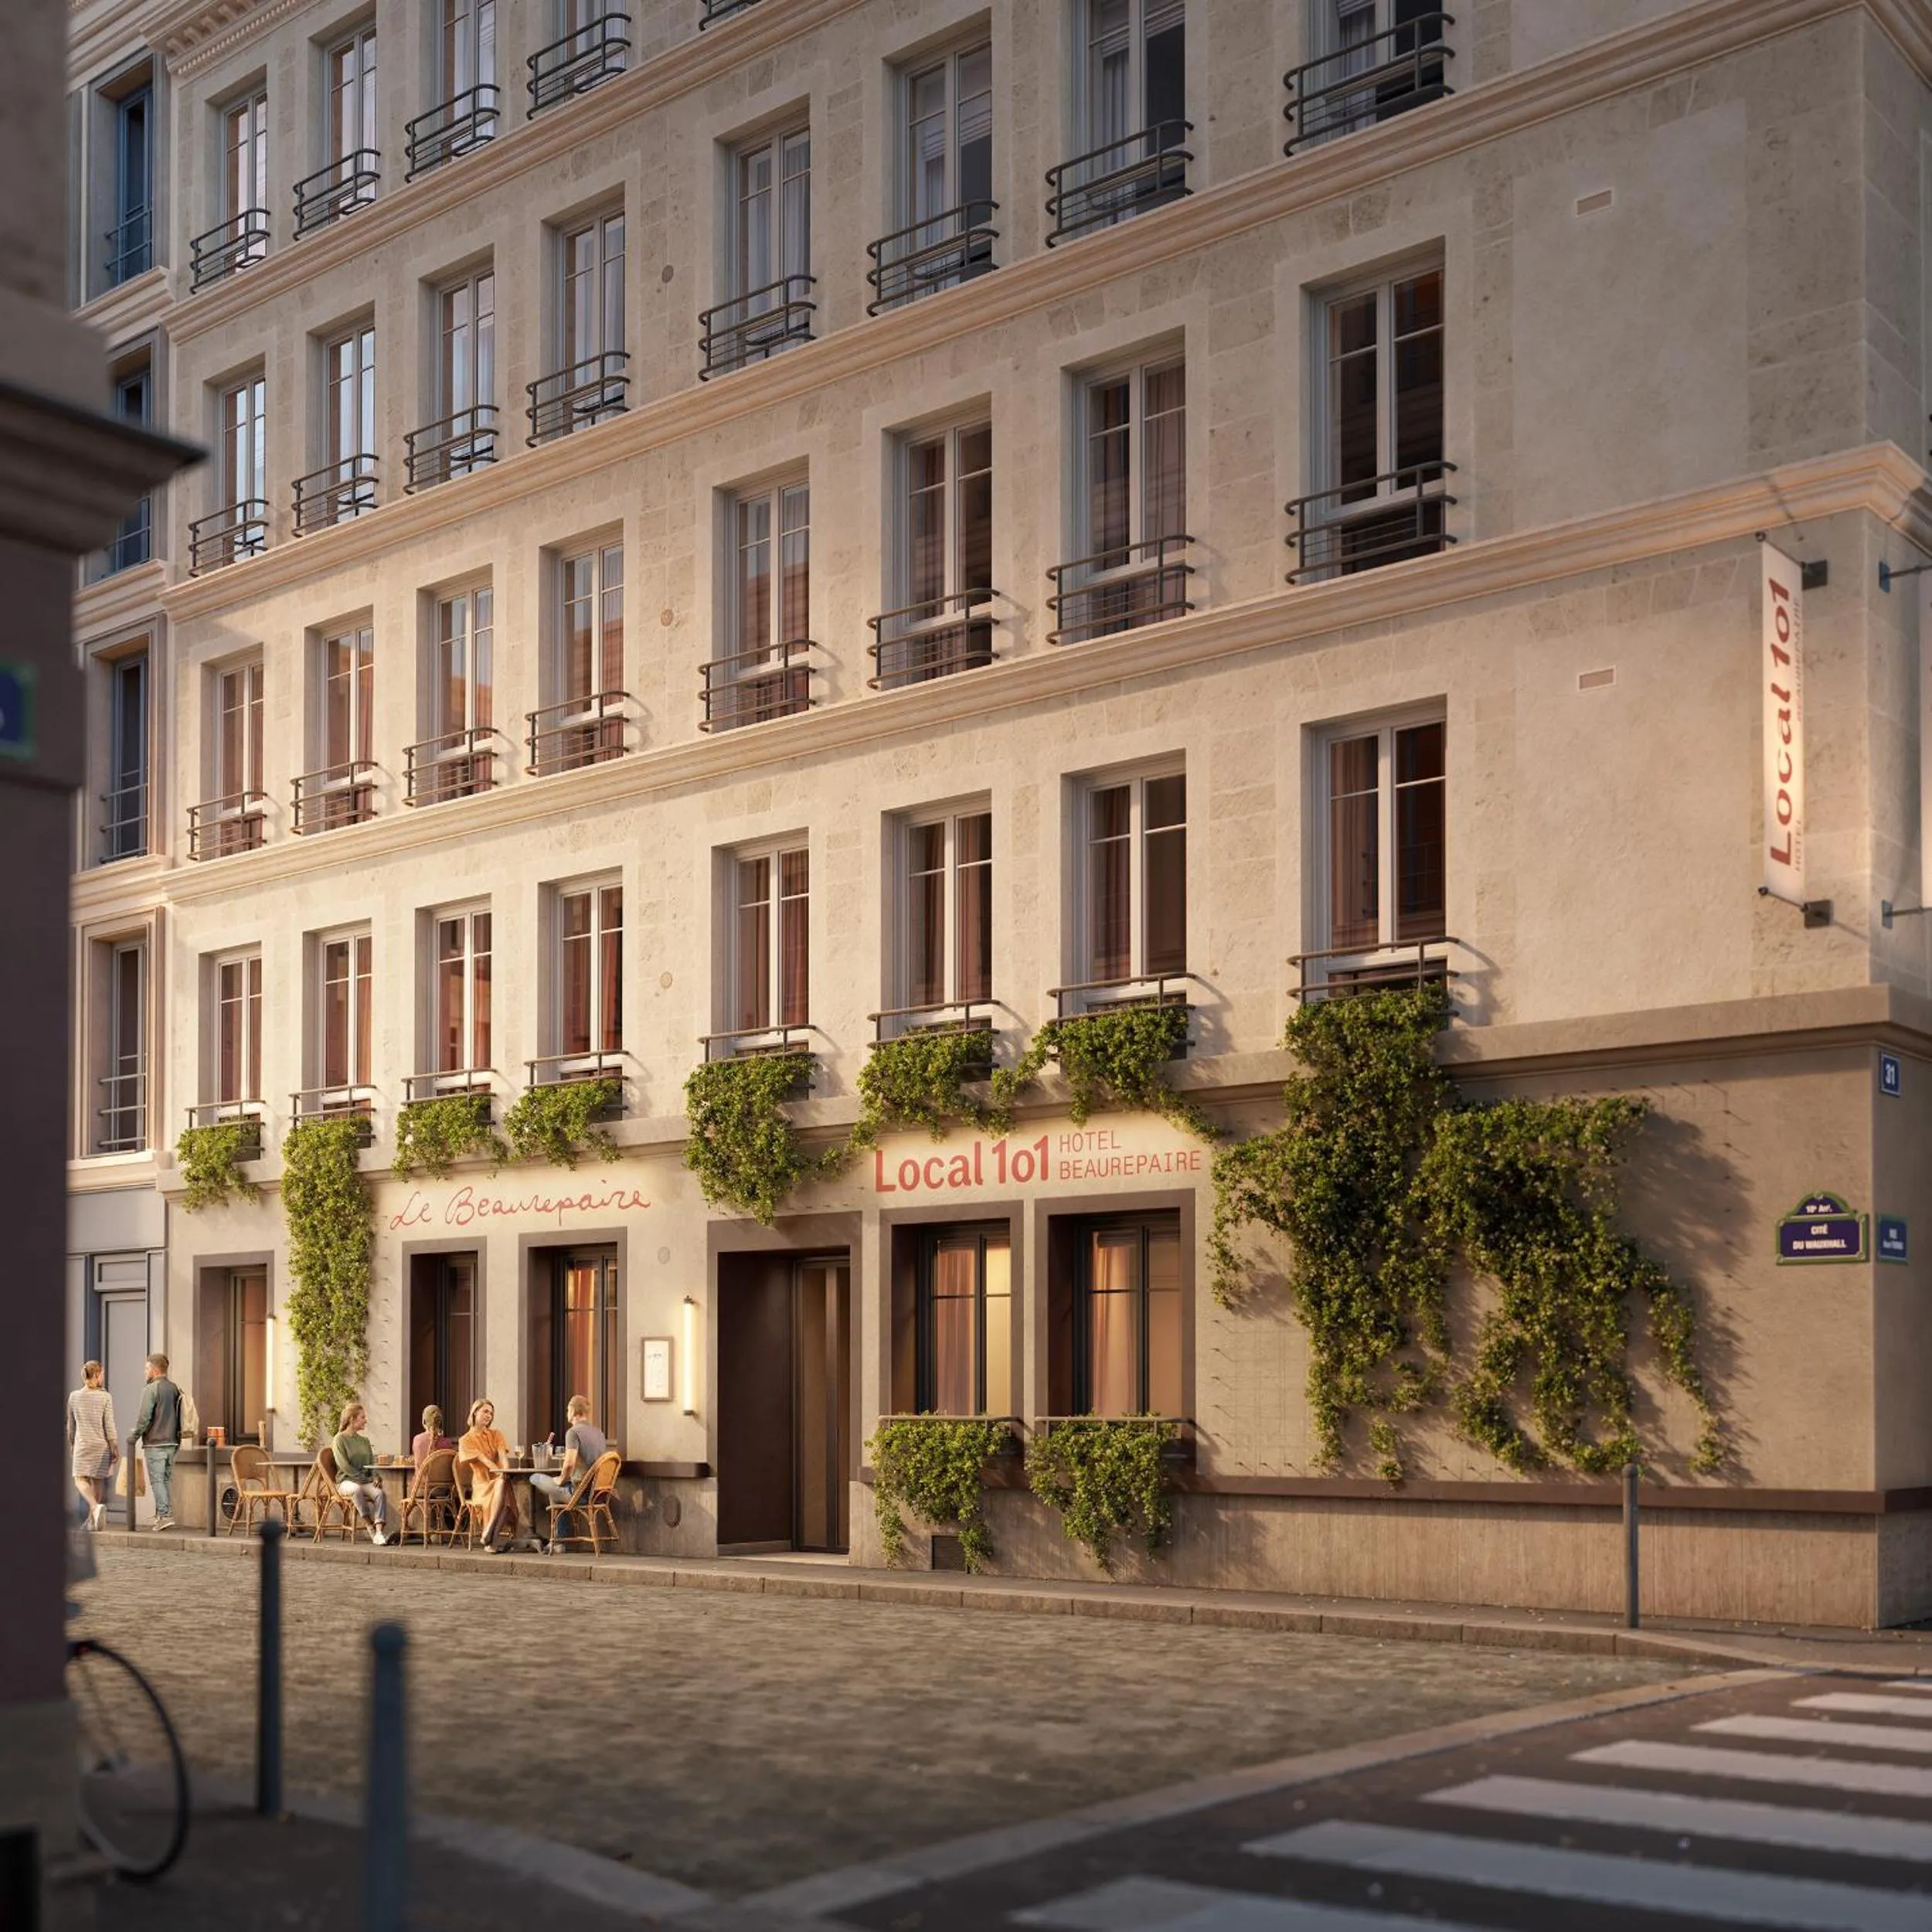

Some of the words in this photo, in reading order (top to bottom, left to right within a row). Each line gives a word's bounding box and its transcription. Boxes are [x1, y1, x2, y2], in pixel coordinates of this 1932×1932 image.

[1770, 682, 1793, 866] Local
[875, 1141, 984, 1193] Local
[1060, 1130, 1123, 1153] HOTEL
[1060, 1149, 1202, 1181] BEAUREPAIRE
[389, 1191, 432, 1231] Le
[445, 1179, 651, 1226] Beaurepaire
